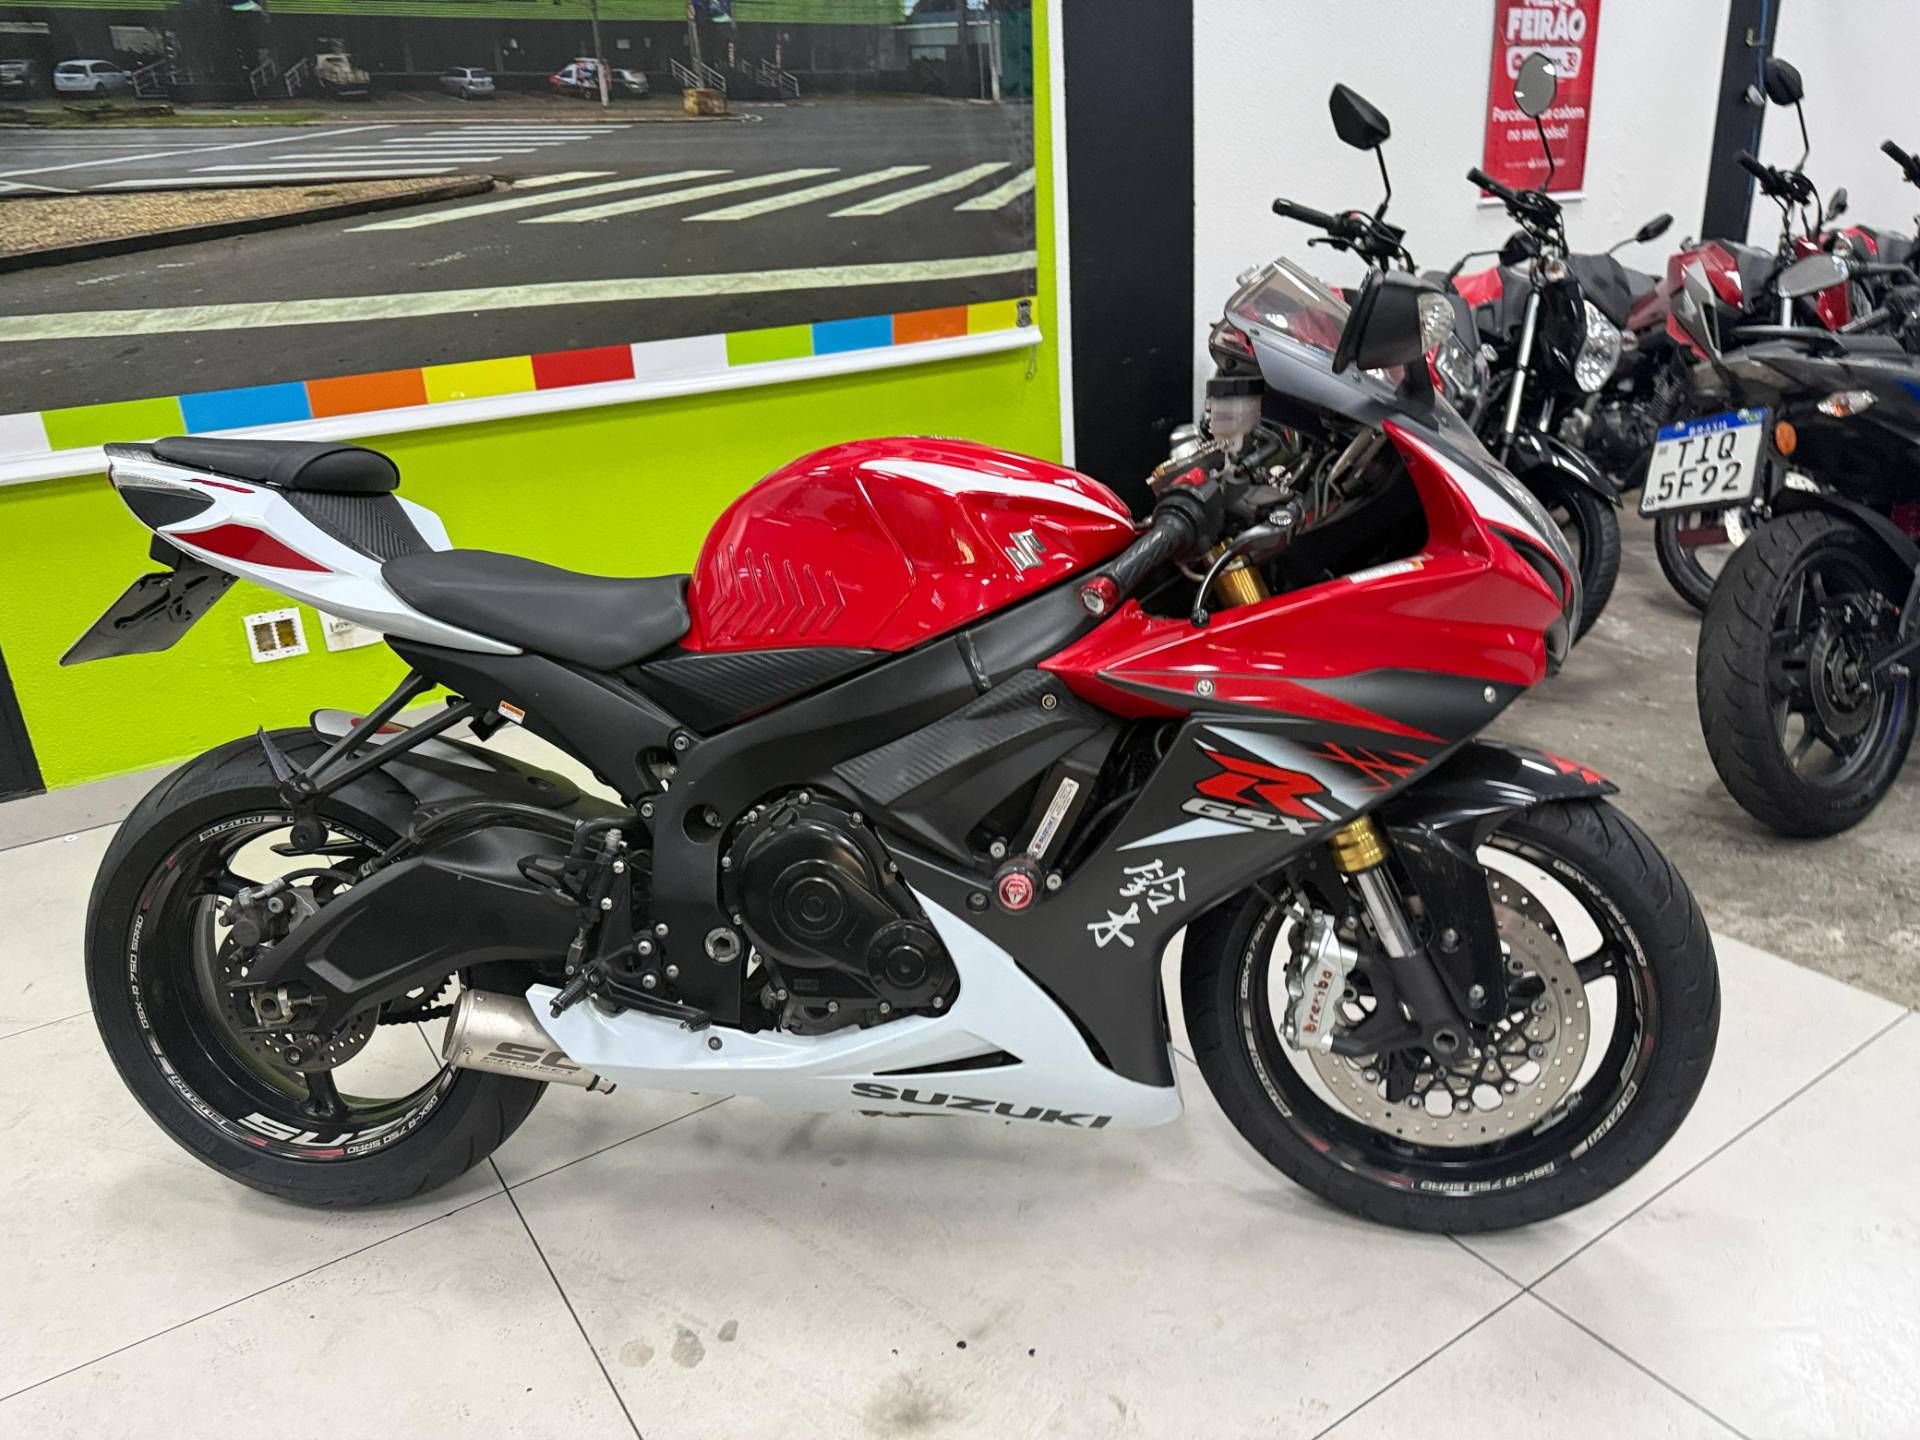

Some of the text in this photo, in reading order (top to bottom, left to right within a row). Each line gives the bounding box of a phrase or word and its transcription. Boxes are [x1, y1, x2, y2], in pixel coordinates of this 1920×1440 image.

[1688, 420, 1728, 437] BRASIL
[1678, 431, 1737, 468] TIQ
[1657, 462, 1742, 501] 5F92
[199, 815, 262, 842] SUZUKI
[1182, 797, 1324, 836] GSX
[129, 914, 150, 1030] GSX-R 750 SRAD
[347, 1094, 439, 1154] GSX-R 750 SRAD
[850, 1082, 1112, 1129] SUZUKI
